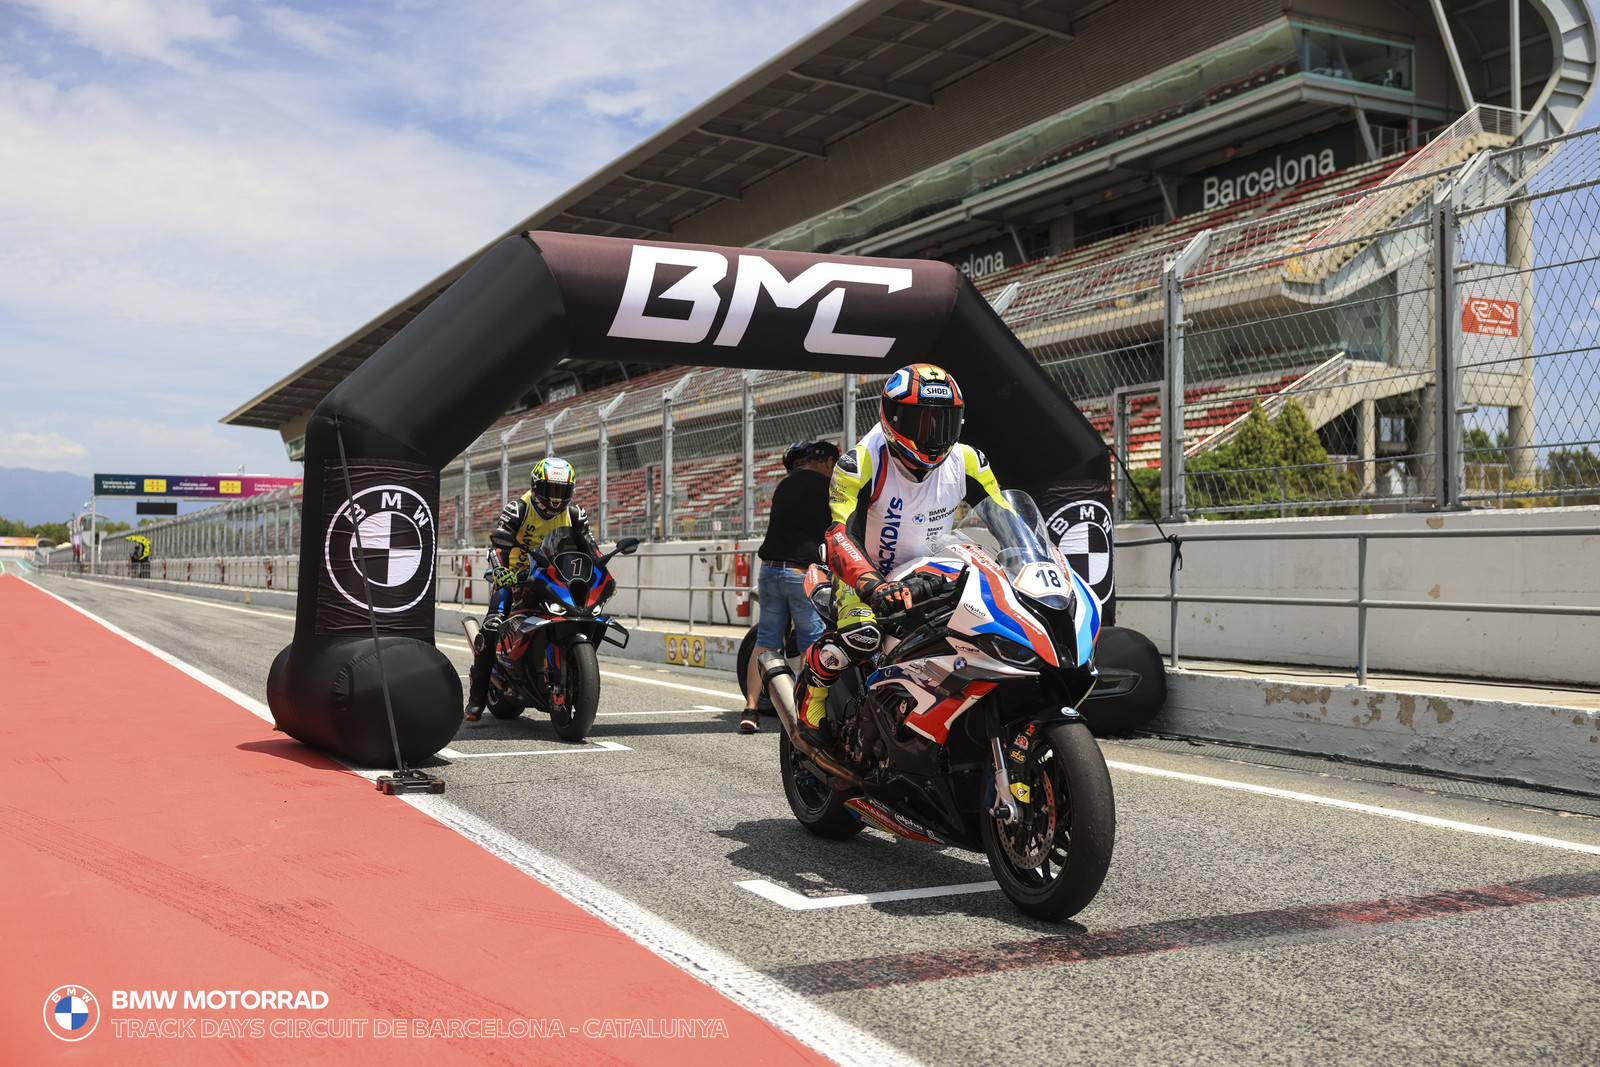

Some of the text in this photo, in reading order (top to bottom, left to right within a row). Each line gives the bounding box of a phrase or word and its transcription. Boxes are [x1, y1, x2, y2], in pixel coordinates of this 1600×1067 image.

[1203, 149, 1336, 209] Barcelona
[960, 251, 1004, 278] elona
[606, 244, 913, 358] BMC
[926, 387, 948, 395] SHOEI
[344, 492, 429, 528] BMW
[928, 506, 947, 517] BMW
[1050, 506, 1112, 536] BMW
[840, 540, 863, 562] MOTOR
[571, 557, 583, 576] 1
[1035, 569, 1062, 588] 18
[896, 813, 924, 831] alpha
